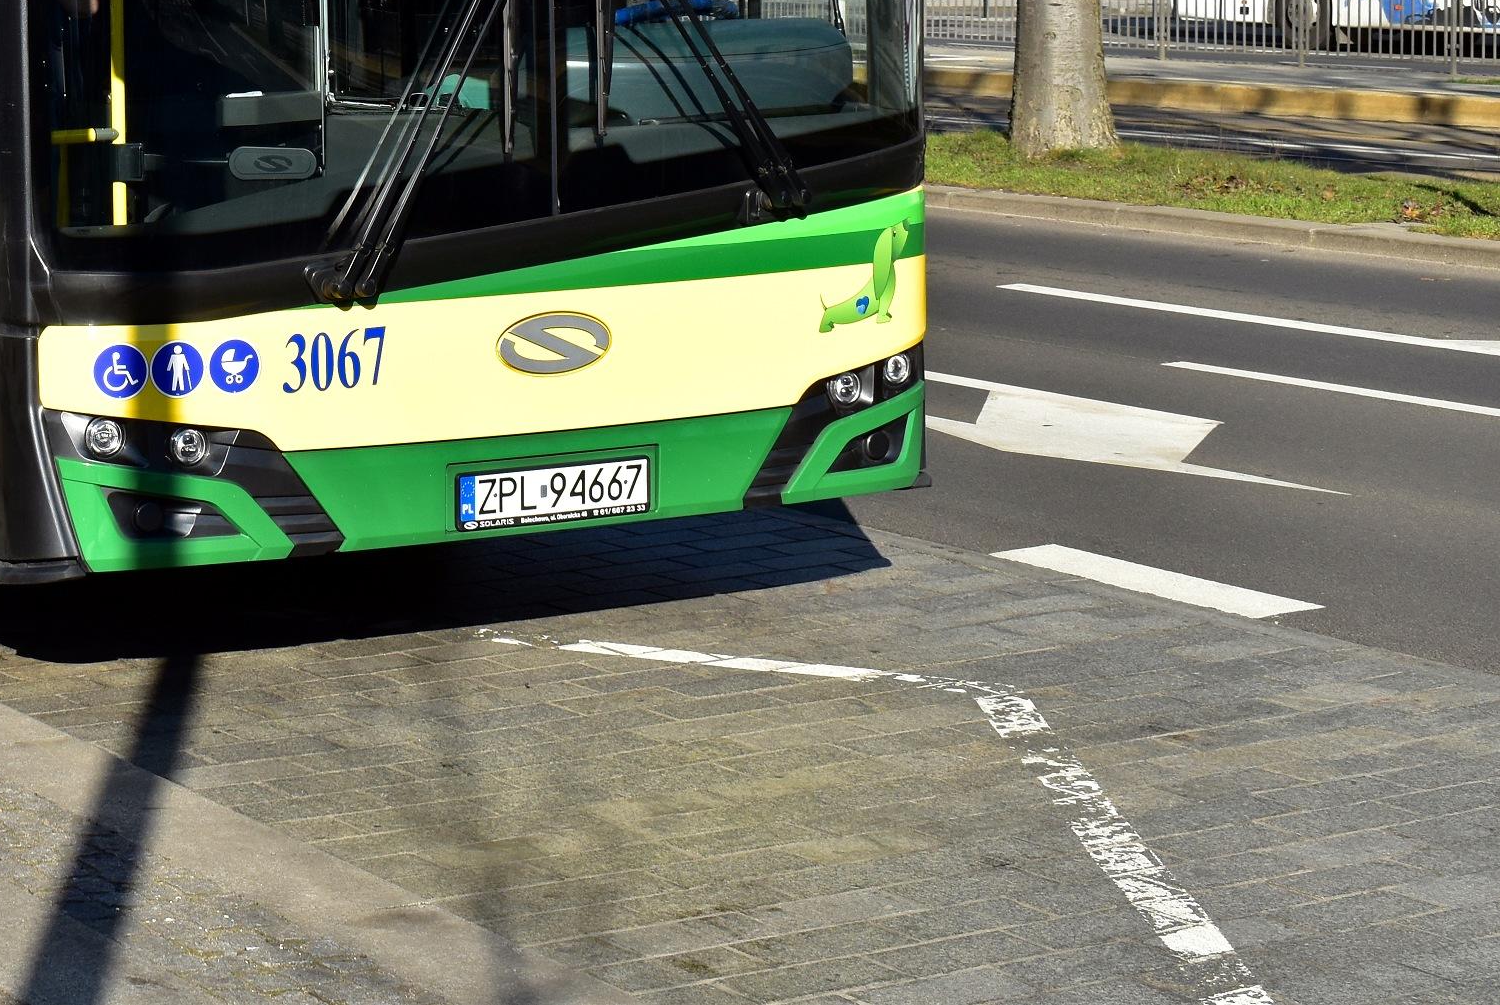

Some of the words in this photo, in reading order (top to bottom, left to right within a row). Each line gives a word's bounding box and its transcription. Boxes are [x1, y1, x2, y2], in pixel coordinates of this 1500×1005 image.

[282, 326, 386, 394] 3067
[478, 475, 537, 515] ZPL
[550, 464, 642, 508] 94667
[462, 503, 474, 515] PL
[479, 517, 515, 528] SOLARIS
[636, 504, 646, 512] 33
